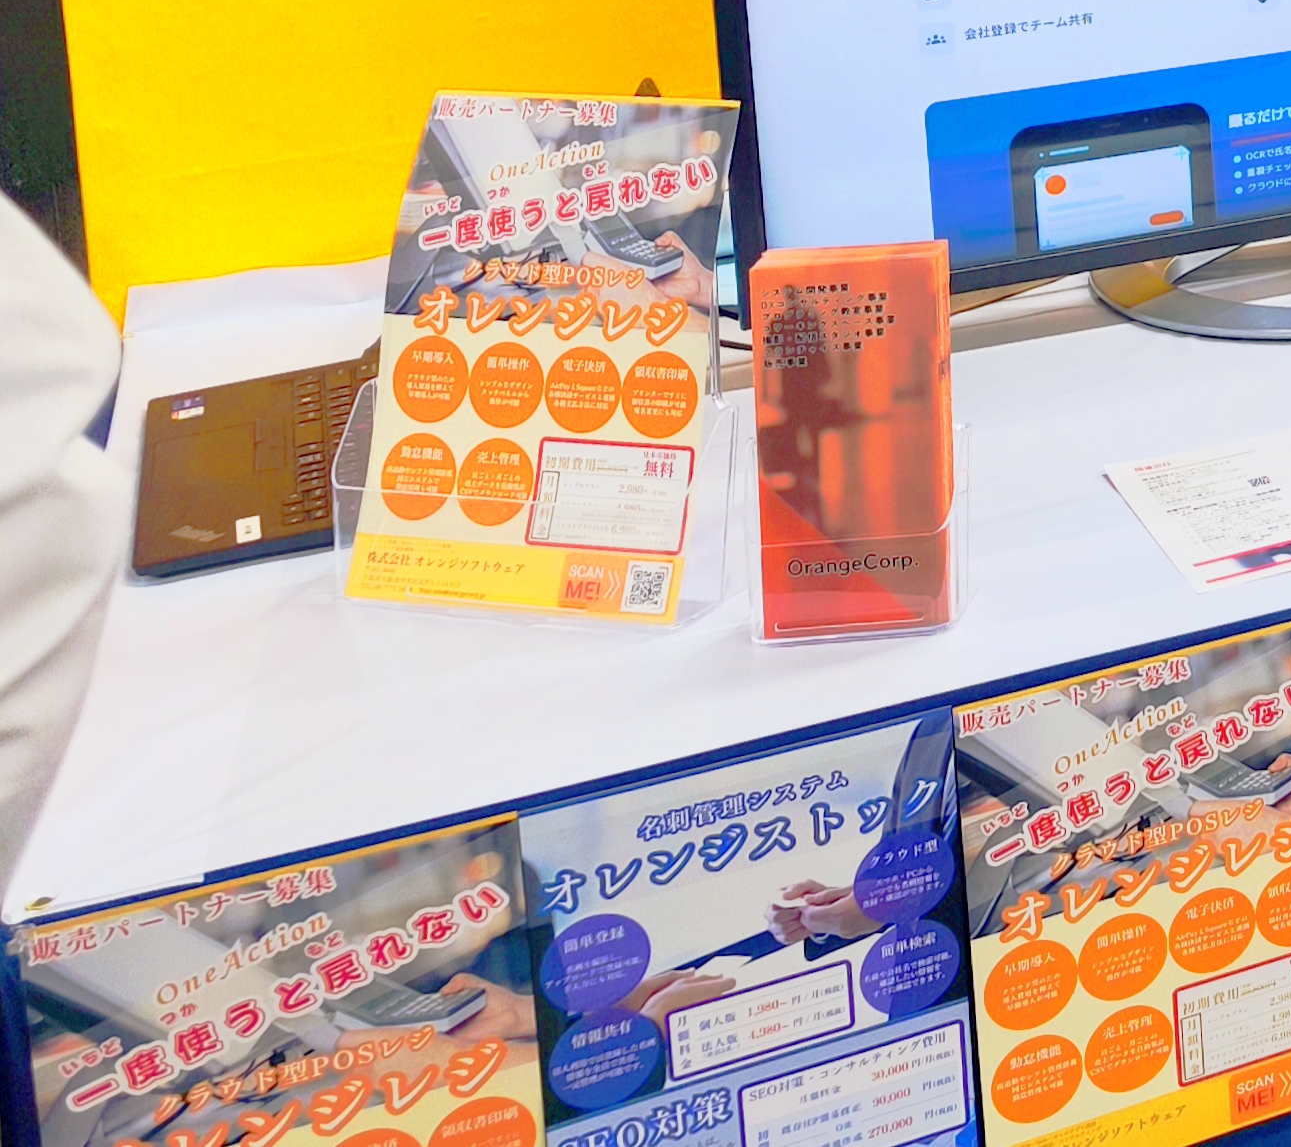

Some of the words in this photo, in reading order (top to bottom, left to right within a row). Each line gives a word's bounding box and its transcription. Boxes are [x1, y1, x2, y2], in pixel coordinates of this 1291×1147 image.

[964, 12, 1094, 42] 会社登録でチーム共有
[435, 98, 618, 126] 販売パートナー募集
[415, 285, 688, 345] オレンジレジ
[569, 565, 605, 581] SCAN
[787, 553, 919, 577] OrangeCorp.
[566, 580, 602, 602] ME!
[963, 654, 1190, 740] 販売パートナー募集
[539, 772, 938, 920] オレンジストック
[31, 863, 336, 969] 販売パートナー募集
[1236, 1071, 1274, 1094] SCAN
[1237, 1084, 1274, 1112] ME!
